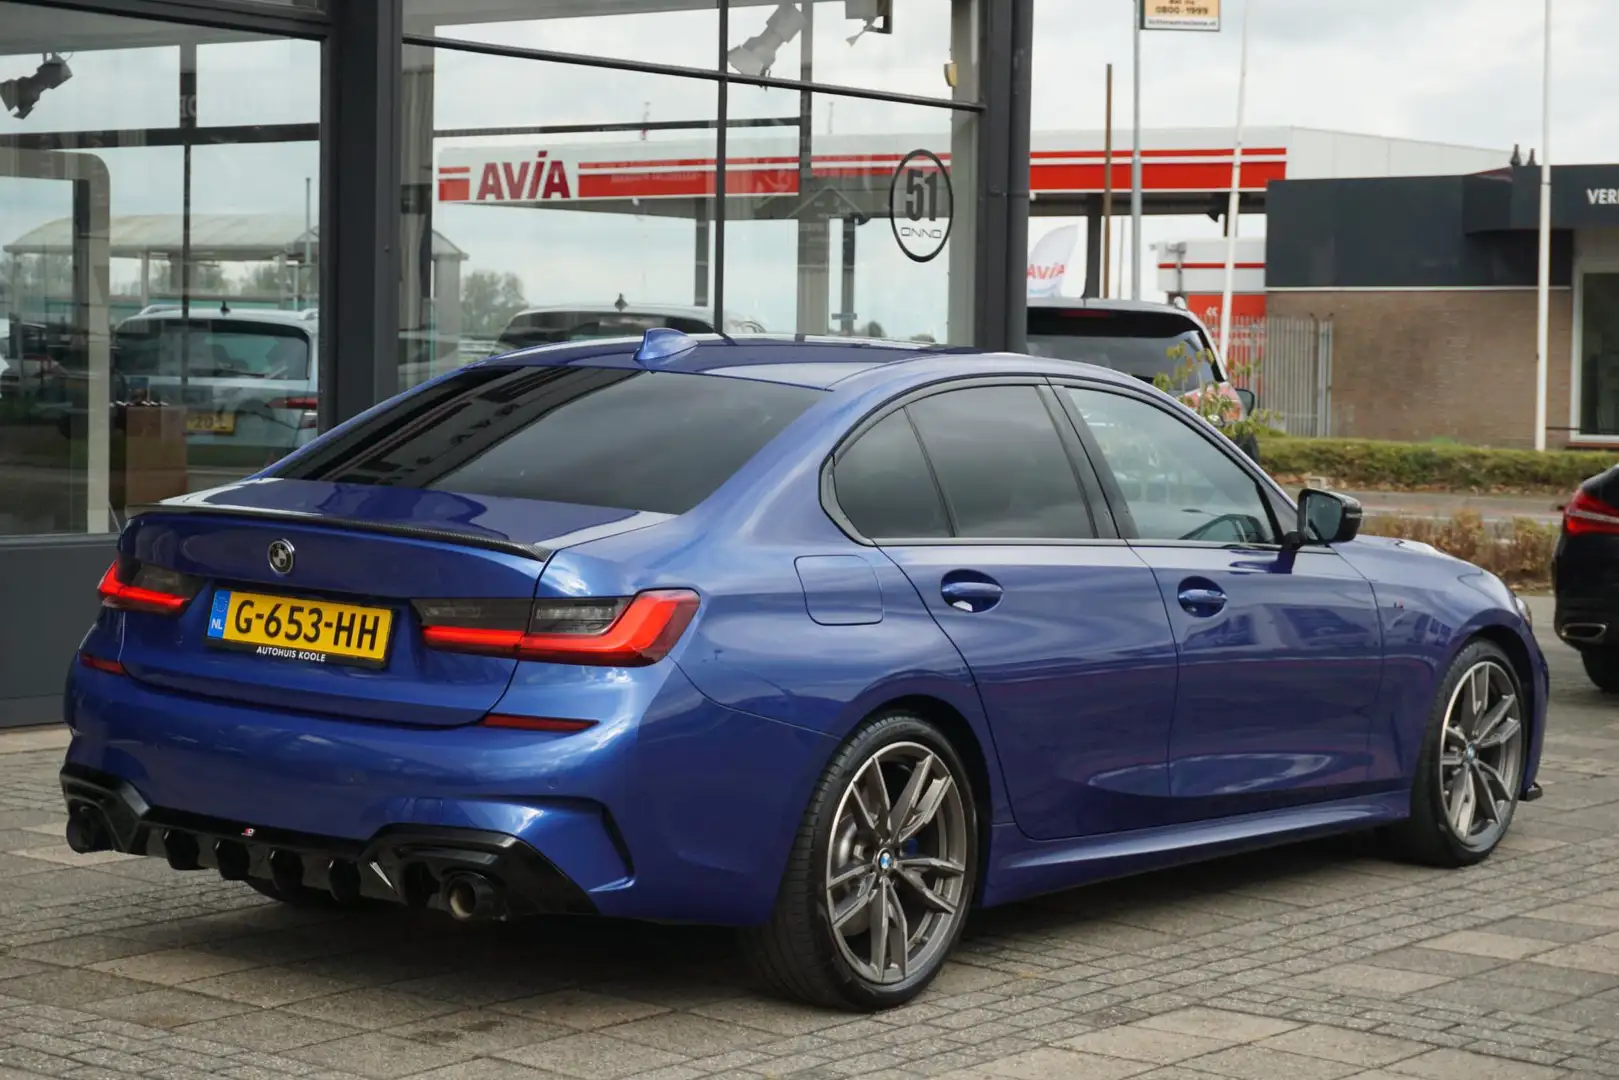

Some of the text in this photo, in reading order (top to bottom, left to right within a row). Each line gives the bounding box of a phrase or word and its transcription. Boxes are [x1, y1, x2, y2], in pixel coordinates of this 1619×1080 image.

[905, 169, 937, 221] 51
[1586, 188, 1619, 205] VER
[211, 618, 223, 630] NL
[235, 600, 380, 651] G-653-HH
[256, 646, 327, 662] AUTOHUIS KOOLE
